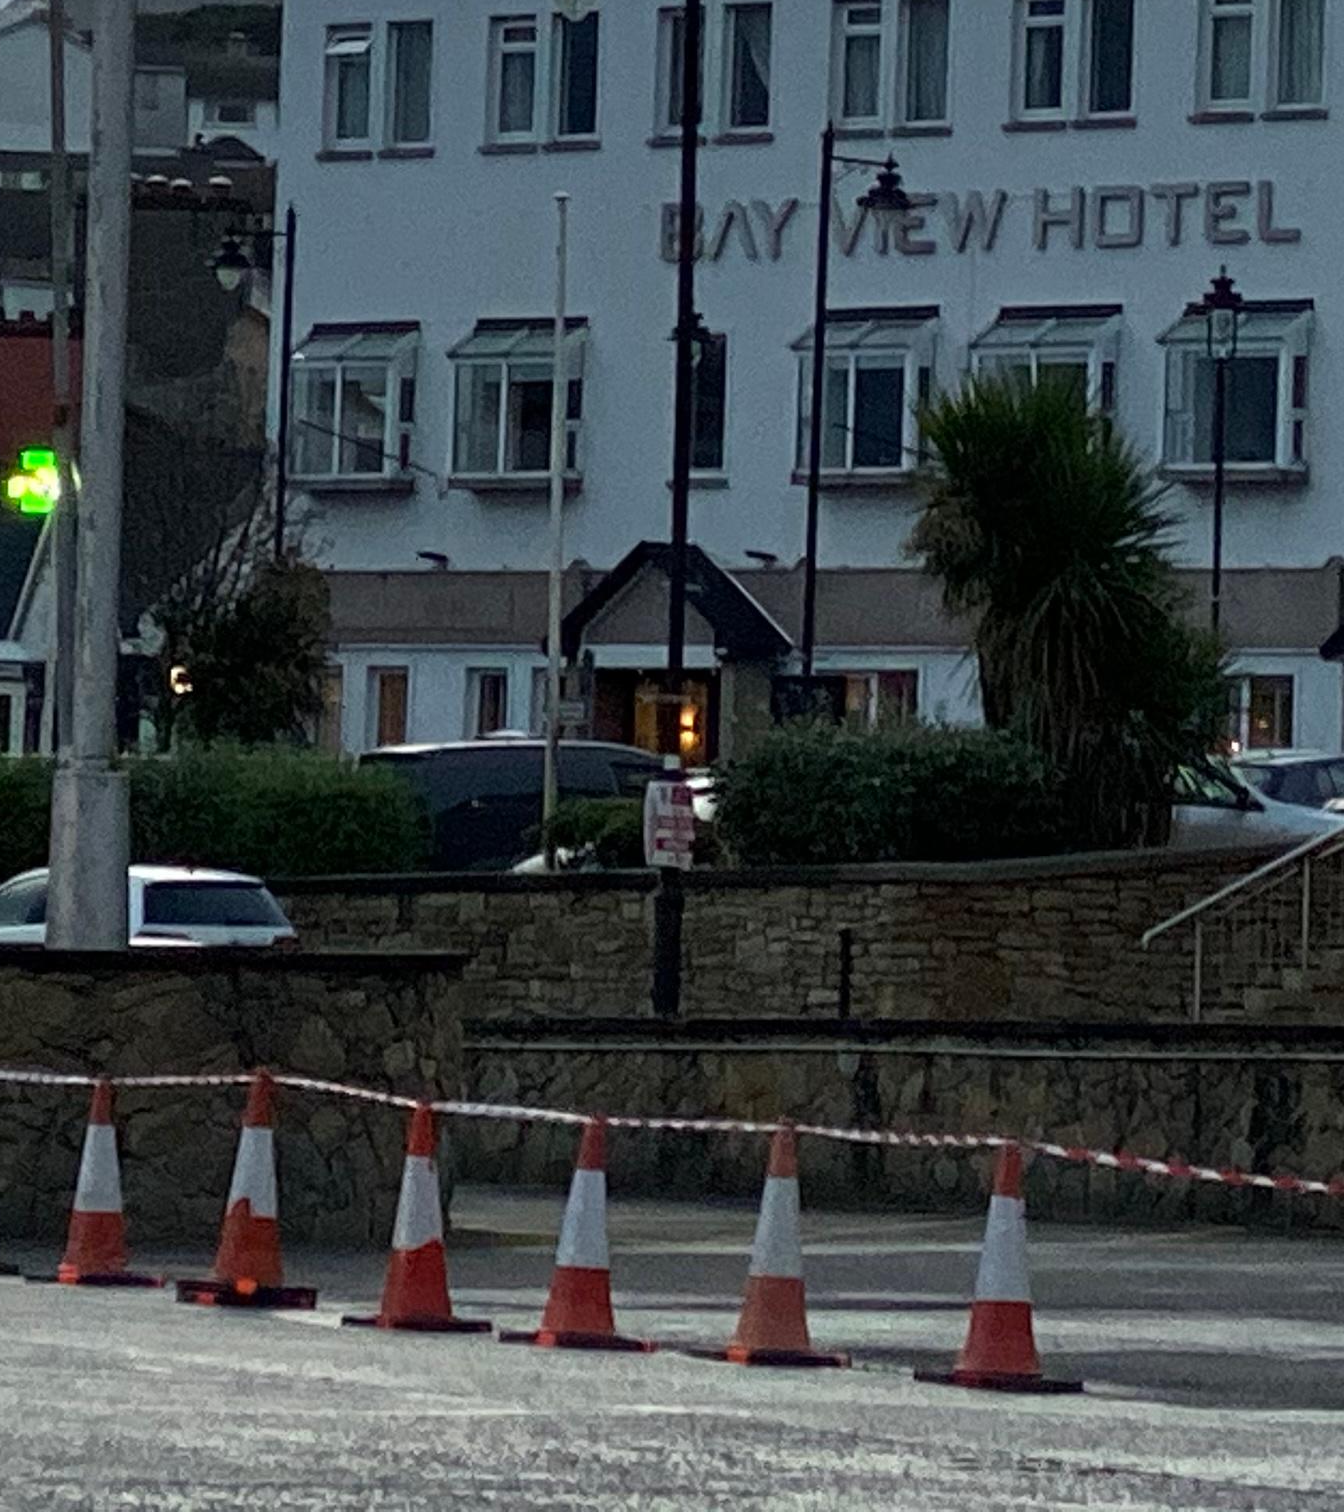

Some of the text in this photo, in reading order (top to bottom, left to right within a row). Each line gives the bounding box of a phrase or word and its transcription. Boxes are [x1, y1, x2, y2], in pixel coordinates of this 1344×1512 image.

[659, 180, 1302, 263] BAY VIEW HOTEL
